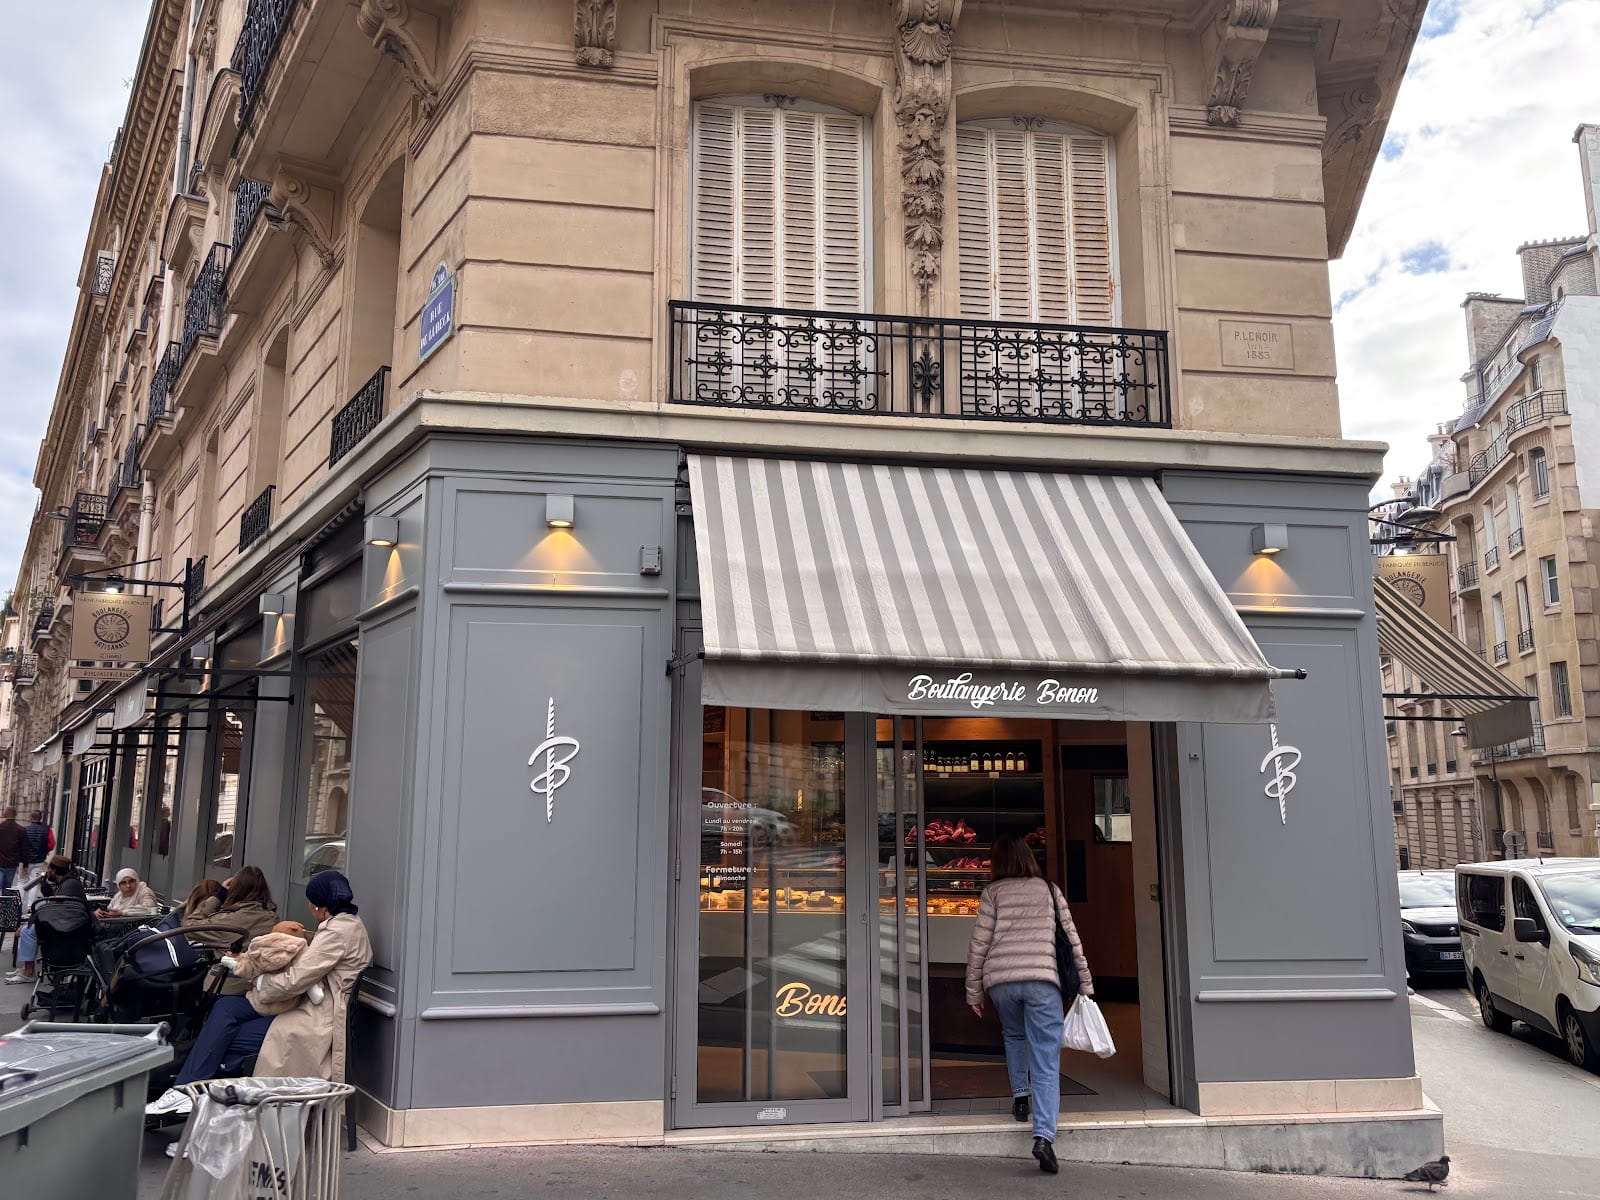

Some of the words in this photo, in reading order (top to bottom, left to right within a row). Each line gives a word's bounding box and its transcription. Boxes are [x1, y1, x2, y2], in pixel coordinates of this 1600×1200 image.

[430, 302, 443, 323] RUE
[1384, 570, 1427, 584] OULANGERIE
[91, 606, 133, 619] BOULANGERIE
[93, 639, 130, 651] ARTISANALE
[907, 672, 1026, 709] Boulangerie
[1036, 678, 1099, 705] Bonon
[707, 801, 752, 809] Ouverture
